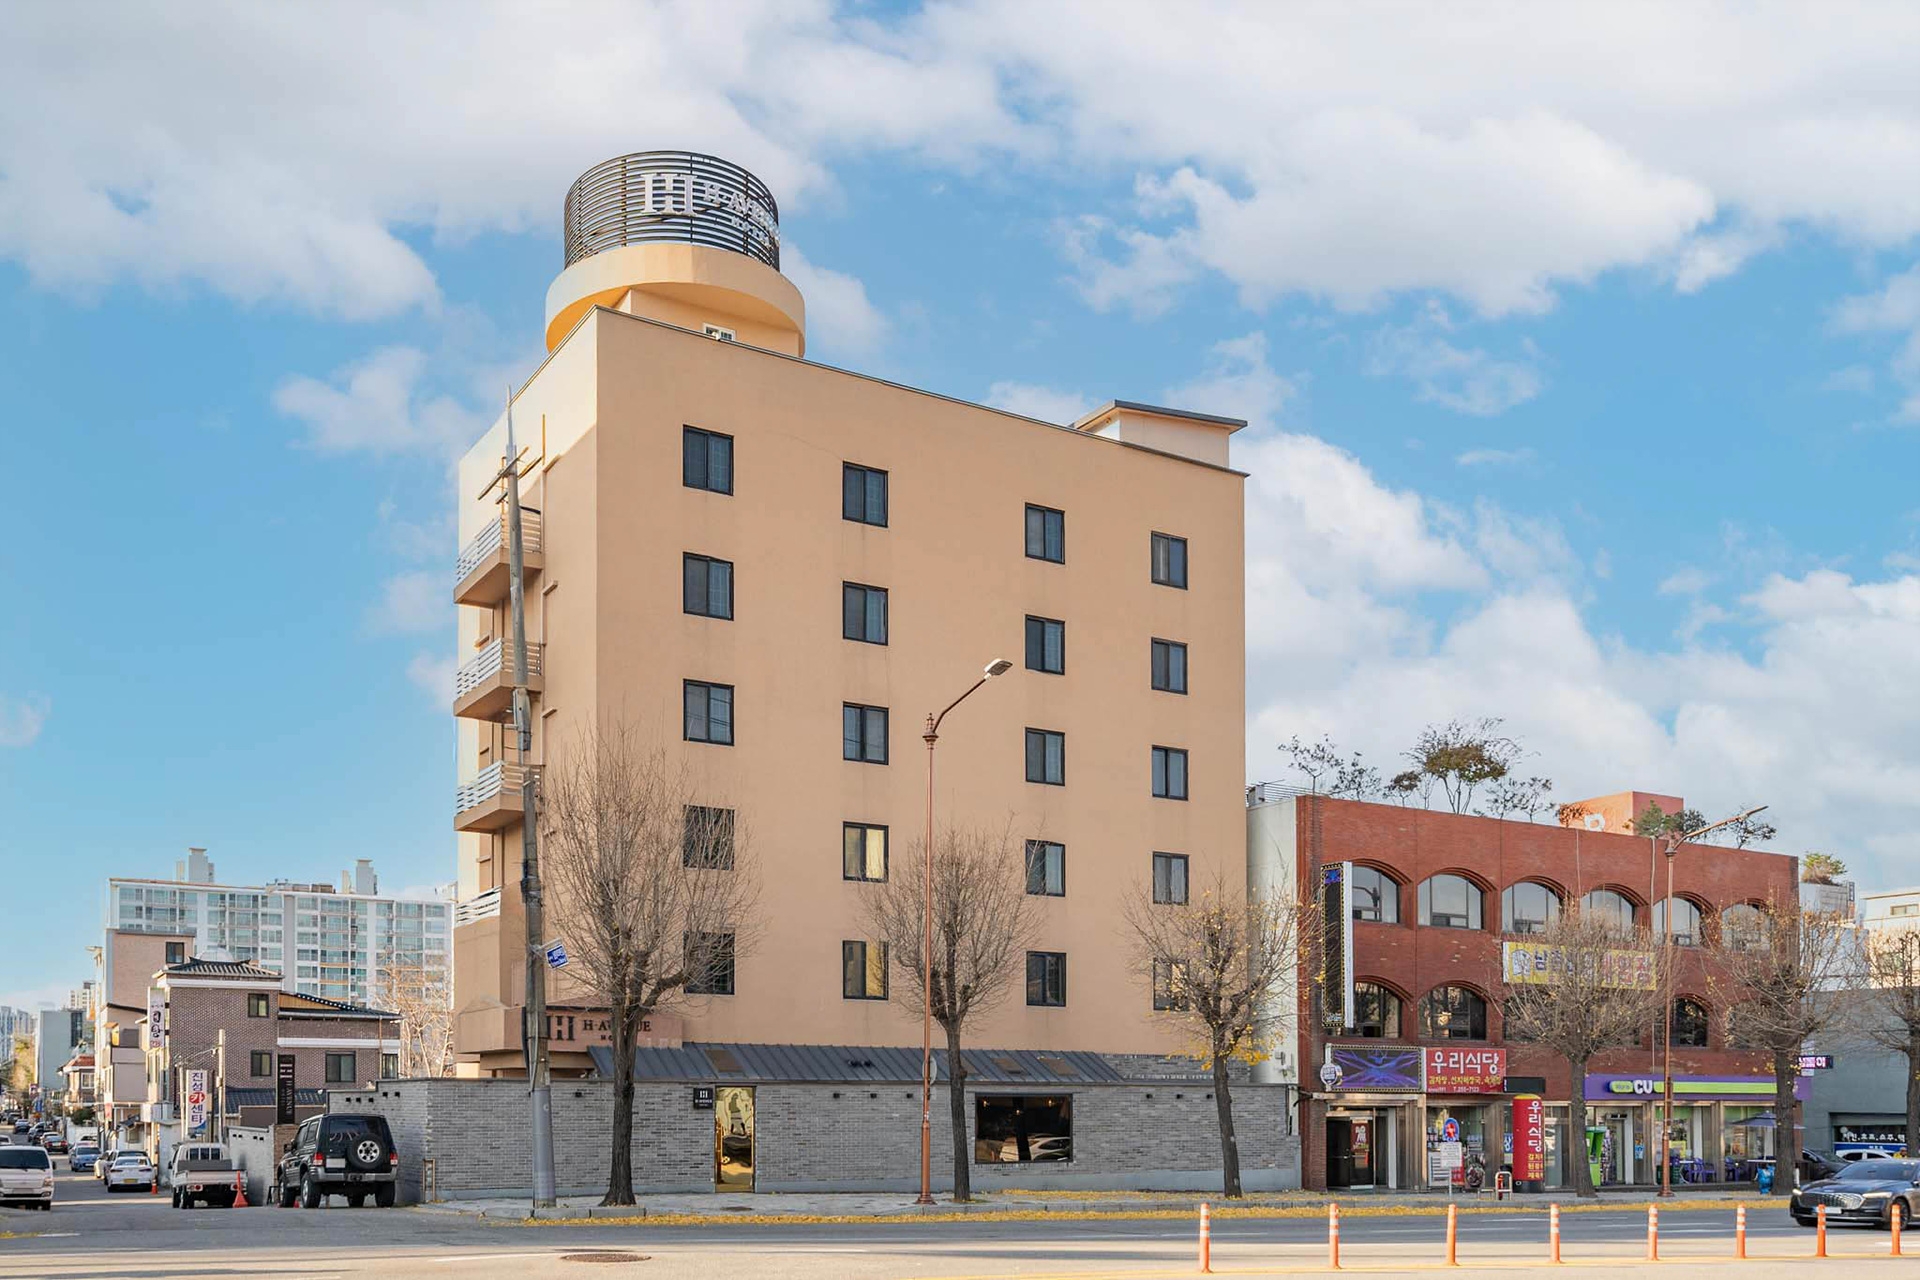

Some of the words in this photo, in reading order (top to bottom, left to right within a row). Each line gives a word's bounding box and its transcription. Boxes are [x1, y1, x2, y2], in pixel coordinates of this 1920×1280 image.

[1430, 1051, 1500, 1075] 우리식당
[1634, 1080, 1653, 1094] CU
[1528, 1101, 1542, 1152] 우리식당
